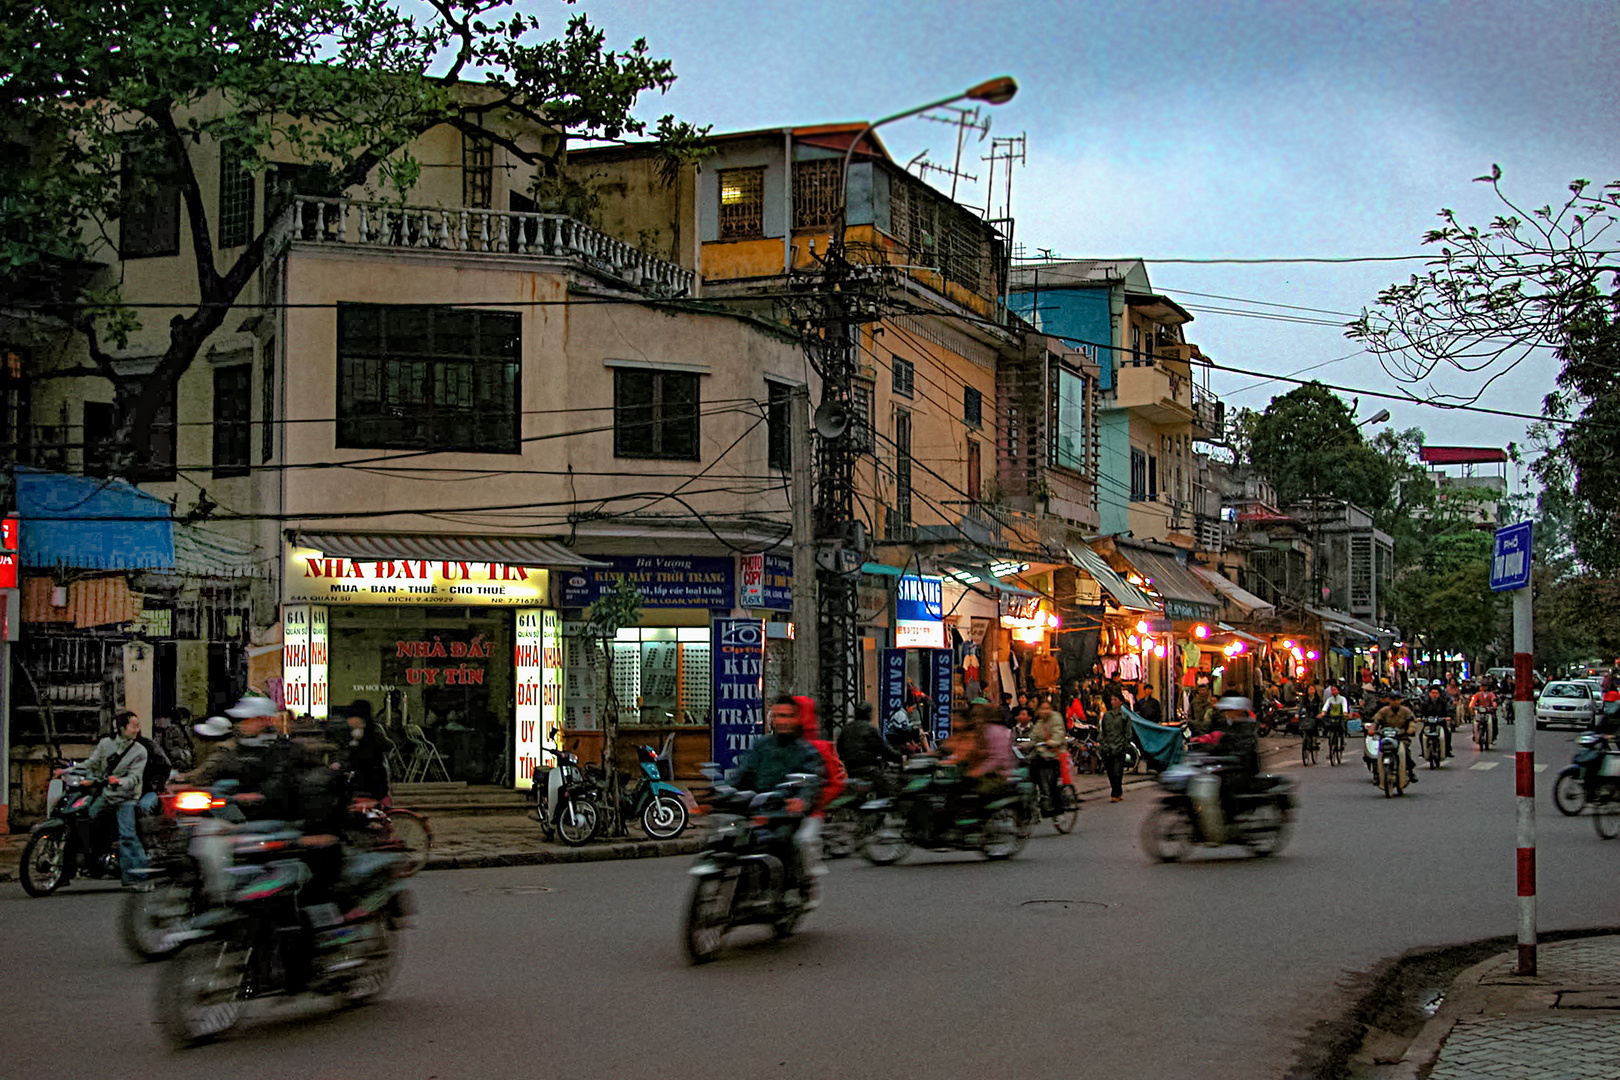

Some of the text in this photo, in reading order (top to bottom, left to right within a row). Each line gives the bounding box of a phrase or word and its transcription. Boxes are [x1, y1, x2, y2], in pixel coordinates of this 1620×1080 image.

[331, 584, 359, 593] MUA
[449, 586, 474, 595] CHO
[898, 580, 941, 603] SAMSUNG
[286, 639, 307, 667] NHÀ
[311, 637, 328, 665] NHÀ
[396, 633, 498, 658] NHÀ ĐẤT
[515, 640, 540, 668] NHÀ
[405, 663, 485, 685] UY TÍN
[889, 656, 903, 716] SAMS
[286, 675, 306, 706] ĐẤT
[517, 676, 539, 706] ĐẤT
[938, 654, 950, 739] SAMSUNG
[521, 720, 536, 743] UY
